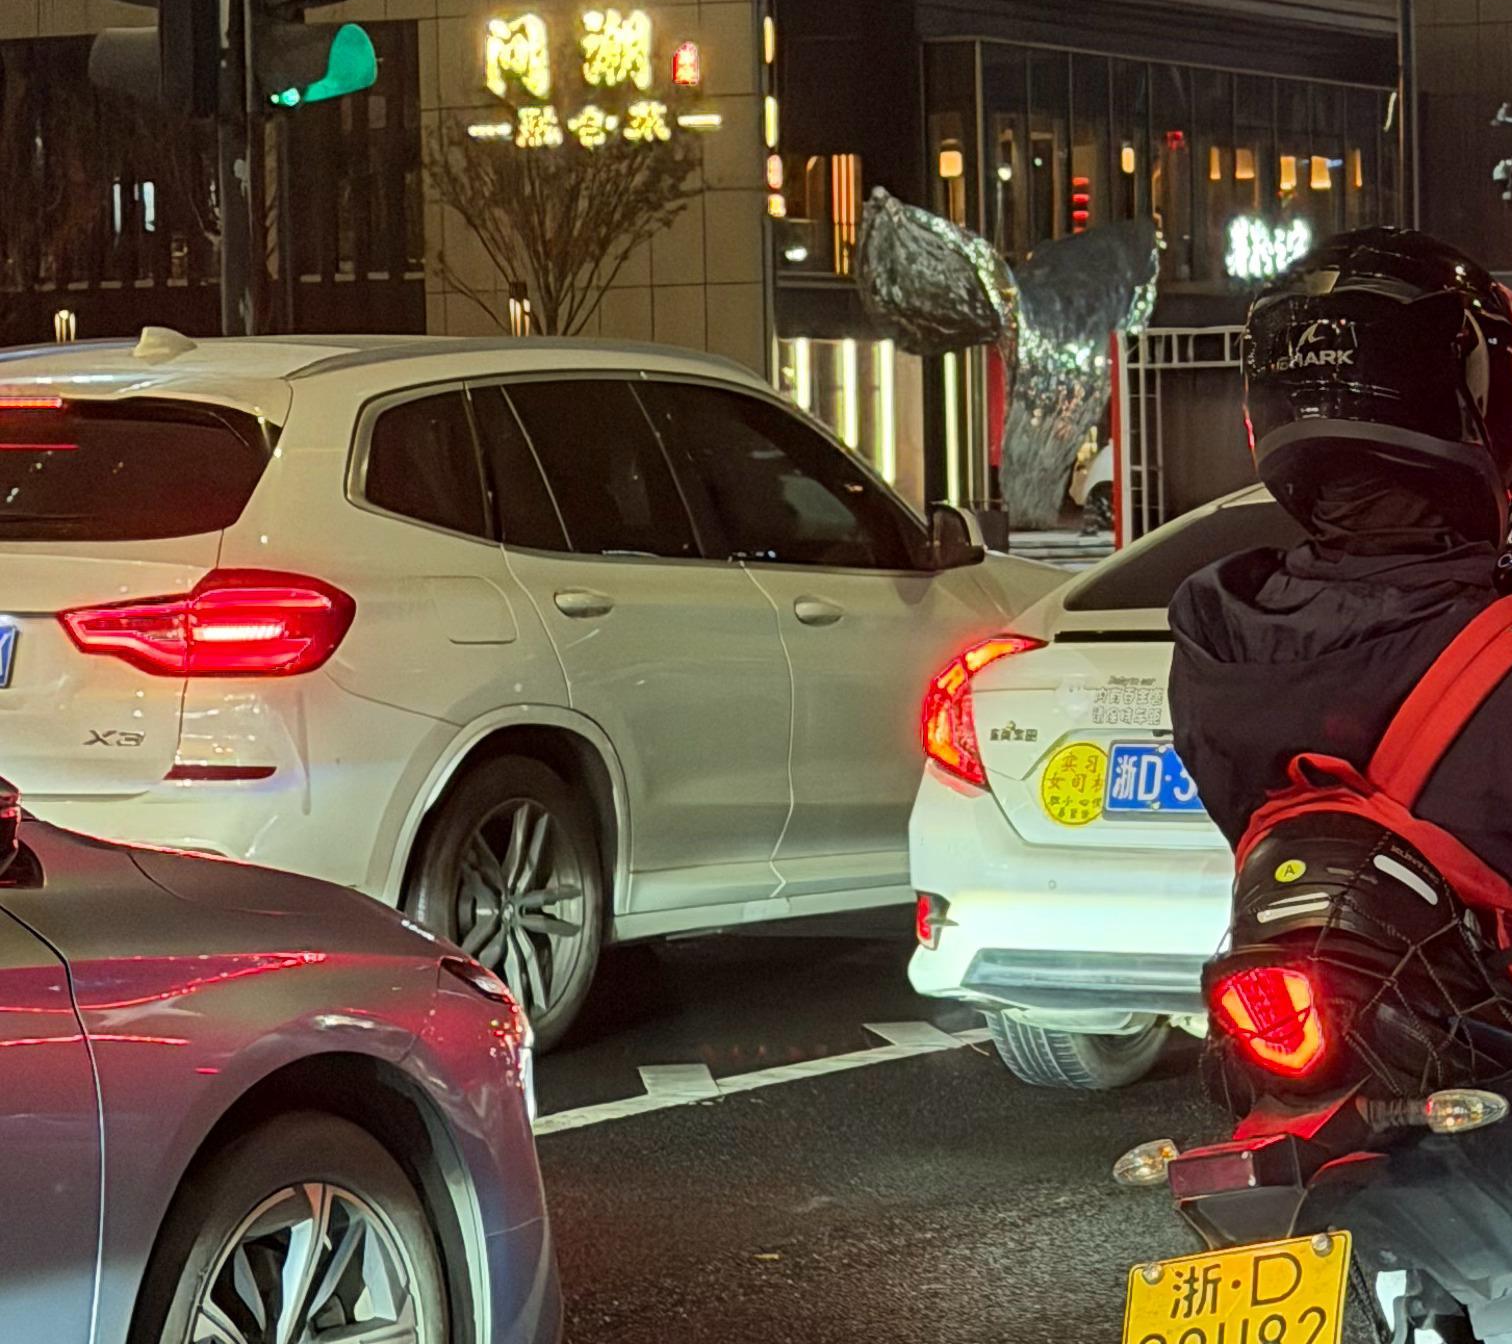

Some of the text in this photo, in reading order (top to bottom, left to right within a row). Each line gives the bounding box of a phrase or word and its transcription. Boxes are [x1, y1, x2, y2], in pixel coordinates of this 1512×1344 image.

[82, 729, 146, 747] X3
[1061, 752, 1099, 774] 实习
[1283, 863, 1296, 878] A
